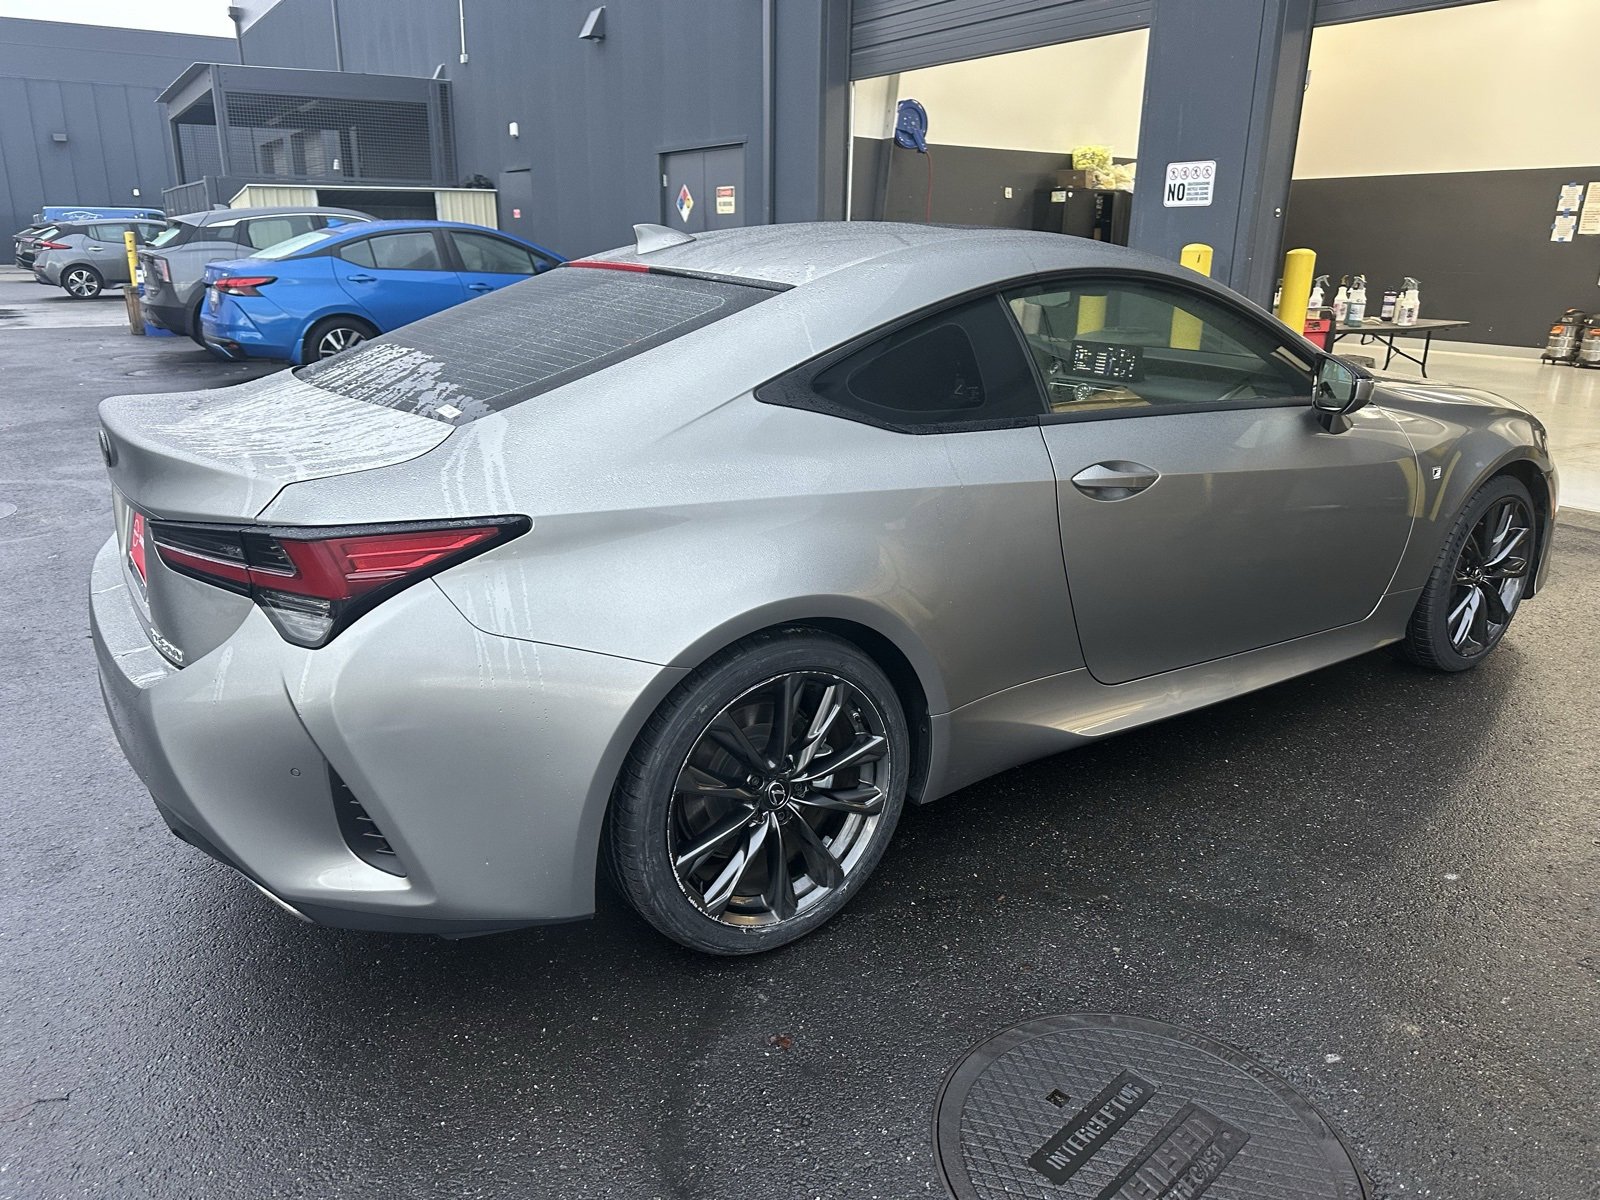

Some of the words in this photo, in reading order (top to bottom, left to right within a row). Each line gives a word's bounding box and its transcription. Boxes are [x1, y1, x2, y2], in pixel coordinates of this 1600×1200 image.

[1167, 183, 1186, 201] NO
[1046, 1082, 1144, 1171] INTERCEPTOR
[1110, 1119, 1215, 1200] ENSEN
